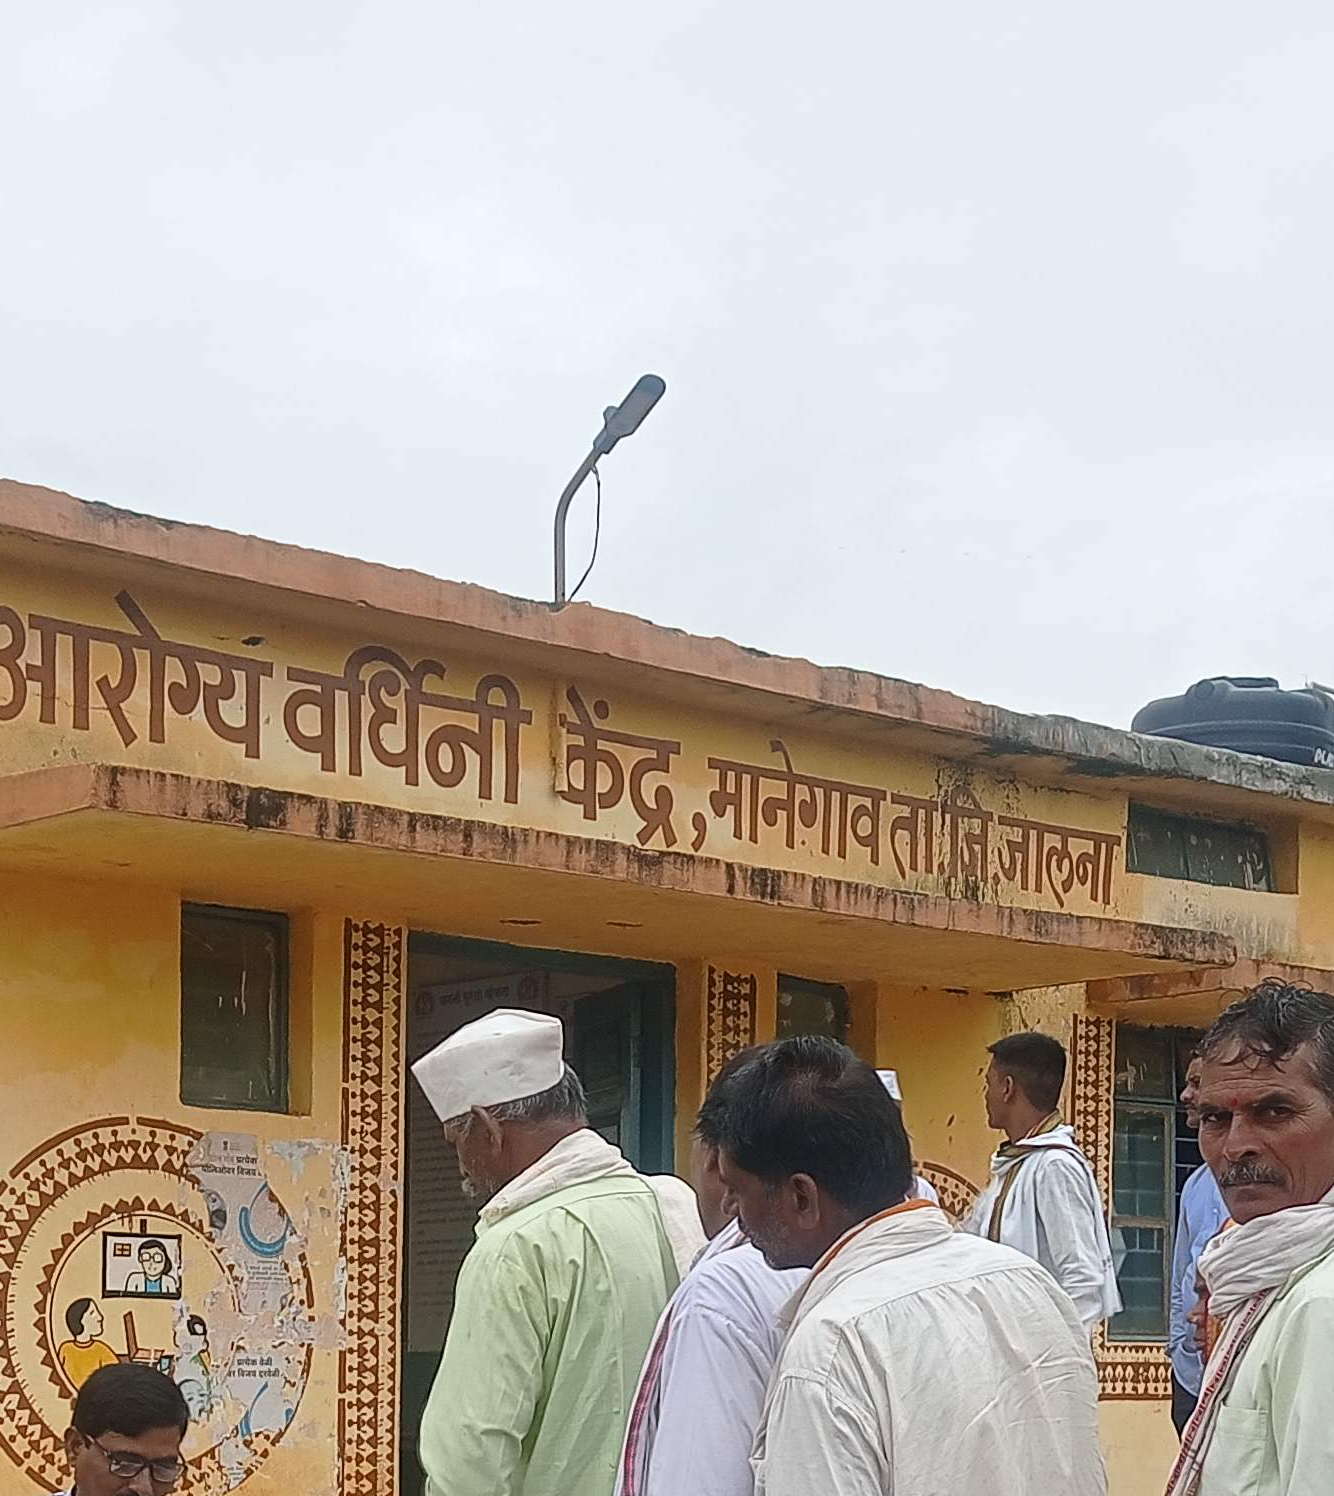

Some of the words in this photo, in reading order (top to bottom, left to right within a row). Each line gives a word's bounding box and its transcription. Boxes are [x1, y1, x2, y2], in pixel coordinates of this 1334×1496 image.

[283, 643, 533, 804] वर्धिनी
[706, 739, 888, 866] मानेगाव
[997, 814, 1122, 909] जालना
